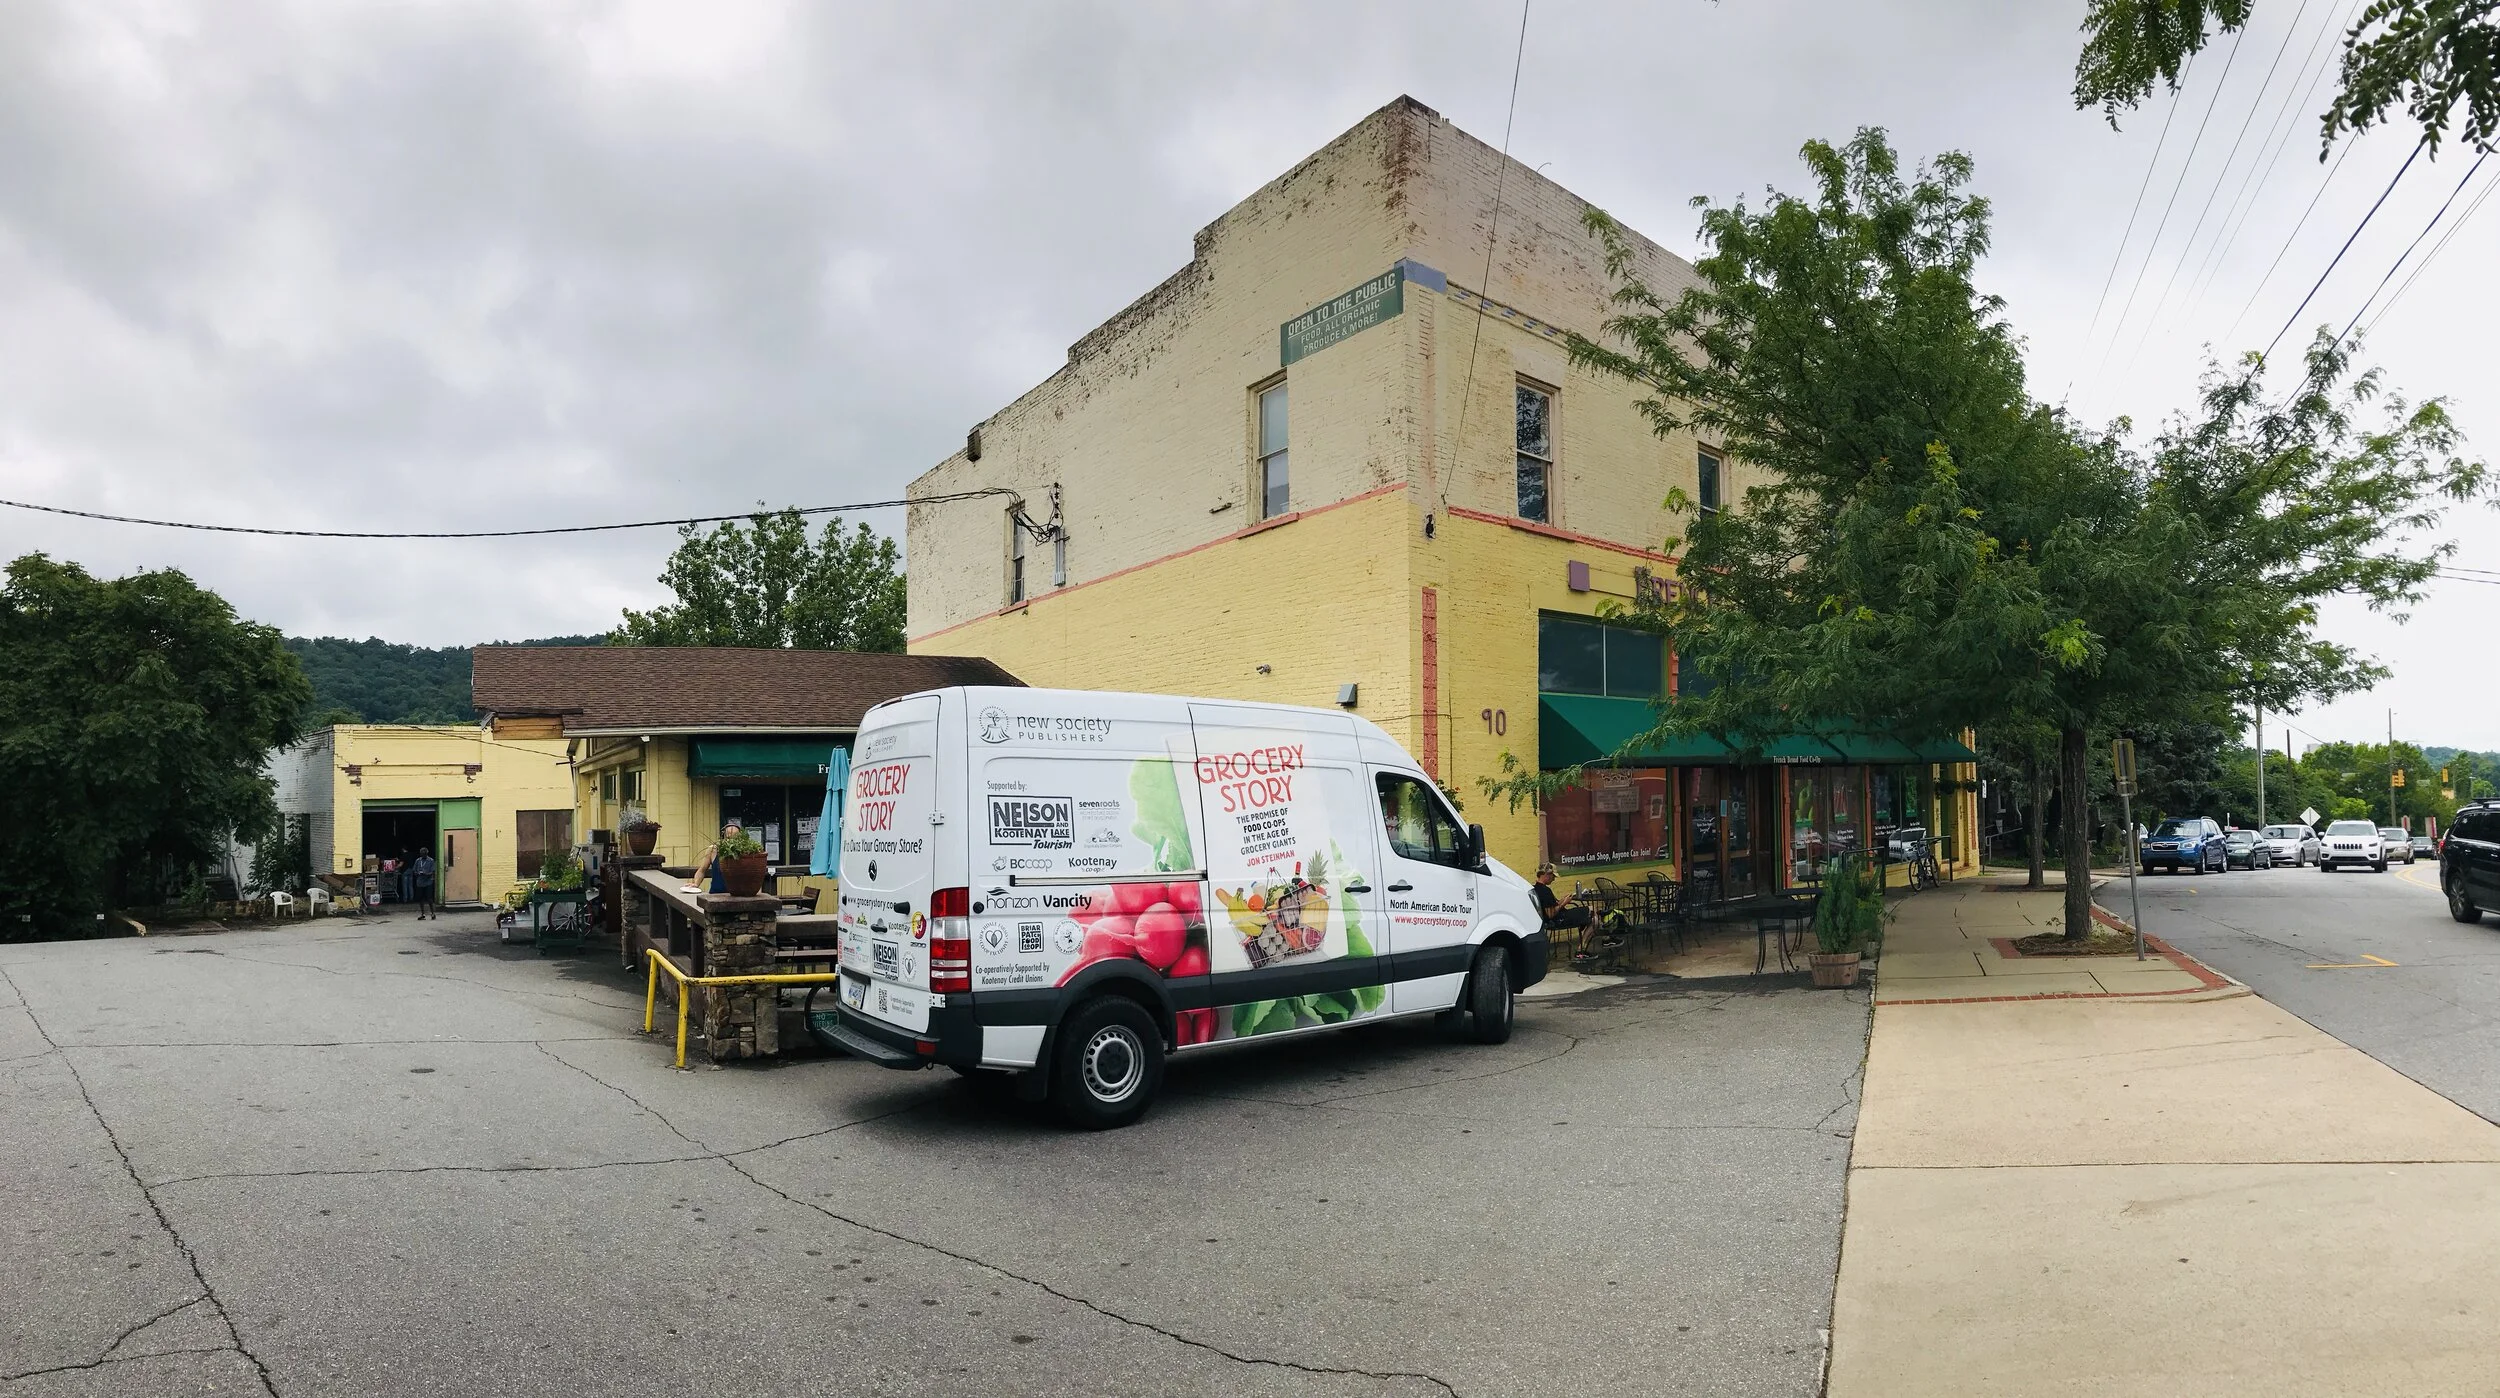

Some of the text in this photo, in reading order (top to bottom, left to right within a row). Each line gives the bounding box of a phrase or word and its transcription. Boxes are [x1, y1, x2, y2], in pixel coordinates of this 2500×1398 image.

[1288, 272, 1396, 336] OPEN TO THE PUBLIC
[1325, 319, 1340, 333] ALL
[1342, 299, 1380, 325] ORGANIC
[1303, 312, 1378, 354] PRODUCE & MORE!
[1016, 716, 1112, 734] new society
[1481, 707, 1507, 736] 90
[1018, 732, 1104, 742] PUBLISHERS
[1193, 744, 1304, 784] GROCERY
[856, 764, 911, 799] GROCERY
[987, 780, 1028, 792] Supported by:
[1220, 775, 1292, 813] STORY
[1078, 800, 1120, 808] sevenroots
[858, 801, 896, 832] STORY
[993, 802, 1068, 827] NELSON
[1236, 807, 1289, 825] THE PROMISE OF
[1051, 828, 1070, 838] LAKE
[1243, 818, 1286, 833] FOOD CO-OPS
[1033, 839, 1073, 850] Tourism
[1243, 828, 1289, 844] IN THE AGE OF
[861, 839, 873, 852] Your
[873, 838, 898, 855] Grocery
[898, 838, 923, 854] Store?
[1240, 836, 1296, 856] GROCERY GIANTS
[1068, 857, 1117, 870] Kootenay
[1246, 849, 1295, 868] JON STEINMAN
[1561, 854, 1585, 865] Everyone
[1586, 852, 1596, 861] Can
[1597, 851, 1611, 862] Shop,
[1611, 850, 1630, 861] Anyone
[1630, 849, 1639, 857] Can
[847, 897, 897, 911] www.grocerystory.coo
[986, 895, 1039, 909] horizon
[1043, 893, 1092, 910] Vancity
[1390, 899, 1472, 914] North American Book Tour
[1394, 914, 1468, 928] www.grocerystory.coop
[873, 943, 898, 963] NELSON
[975, 961, 1050, 975] Co-operatively Supported by
[981, 974, 1043, 986] Kootenay Credit Unions
